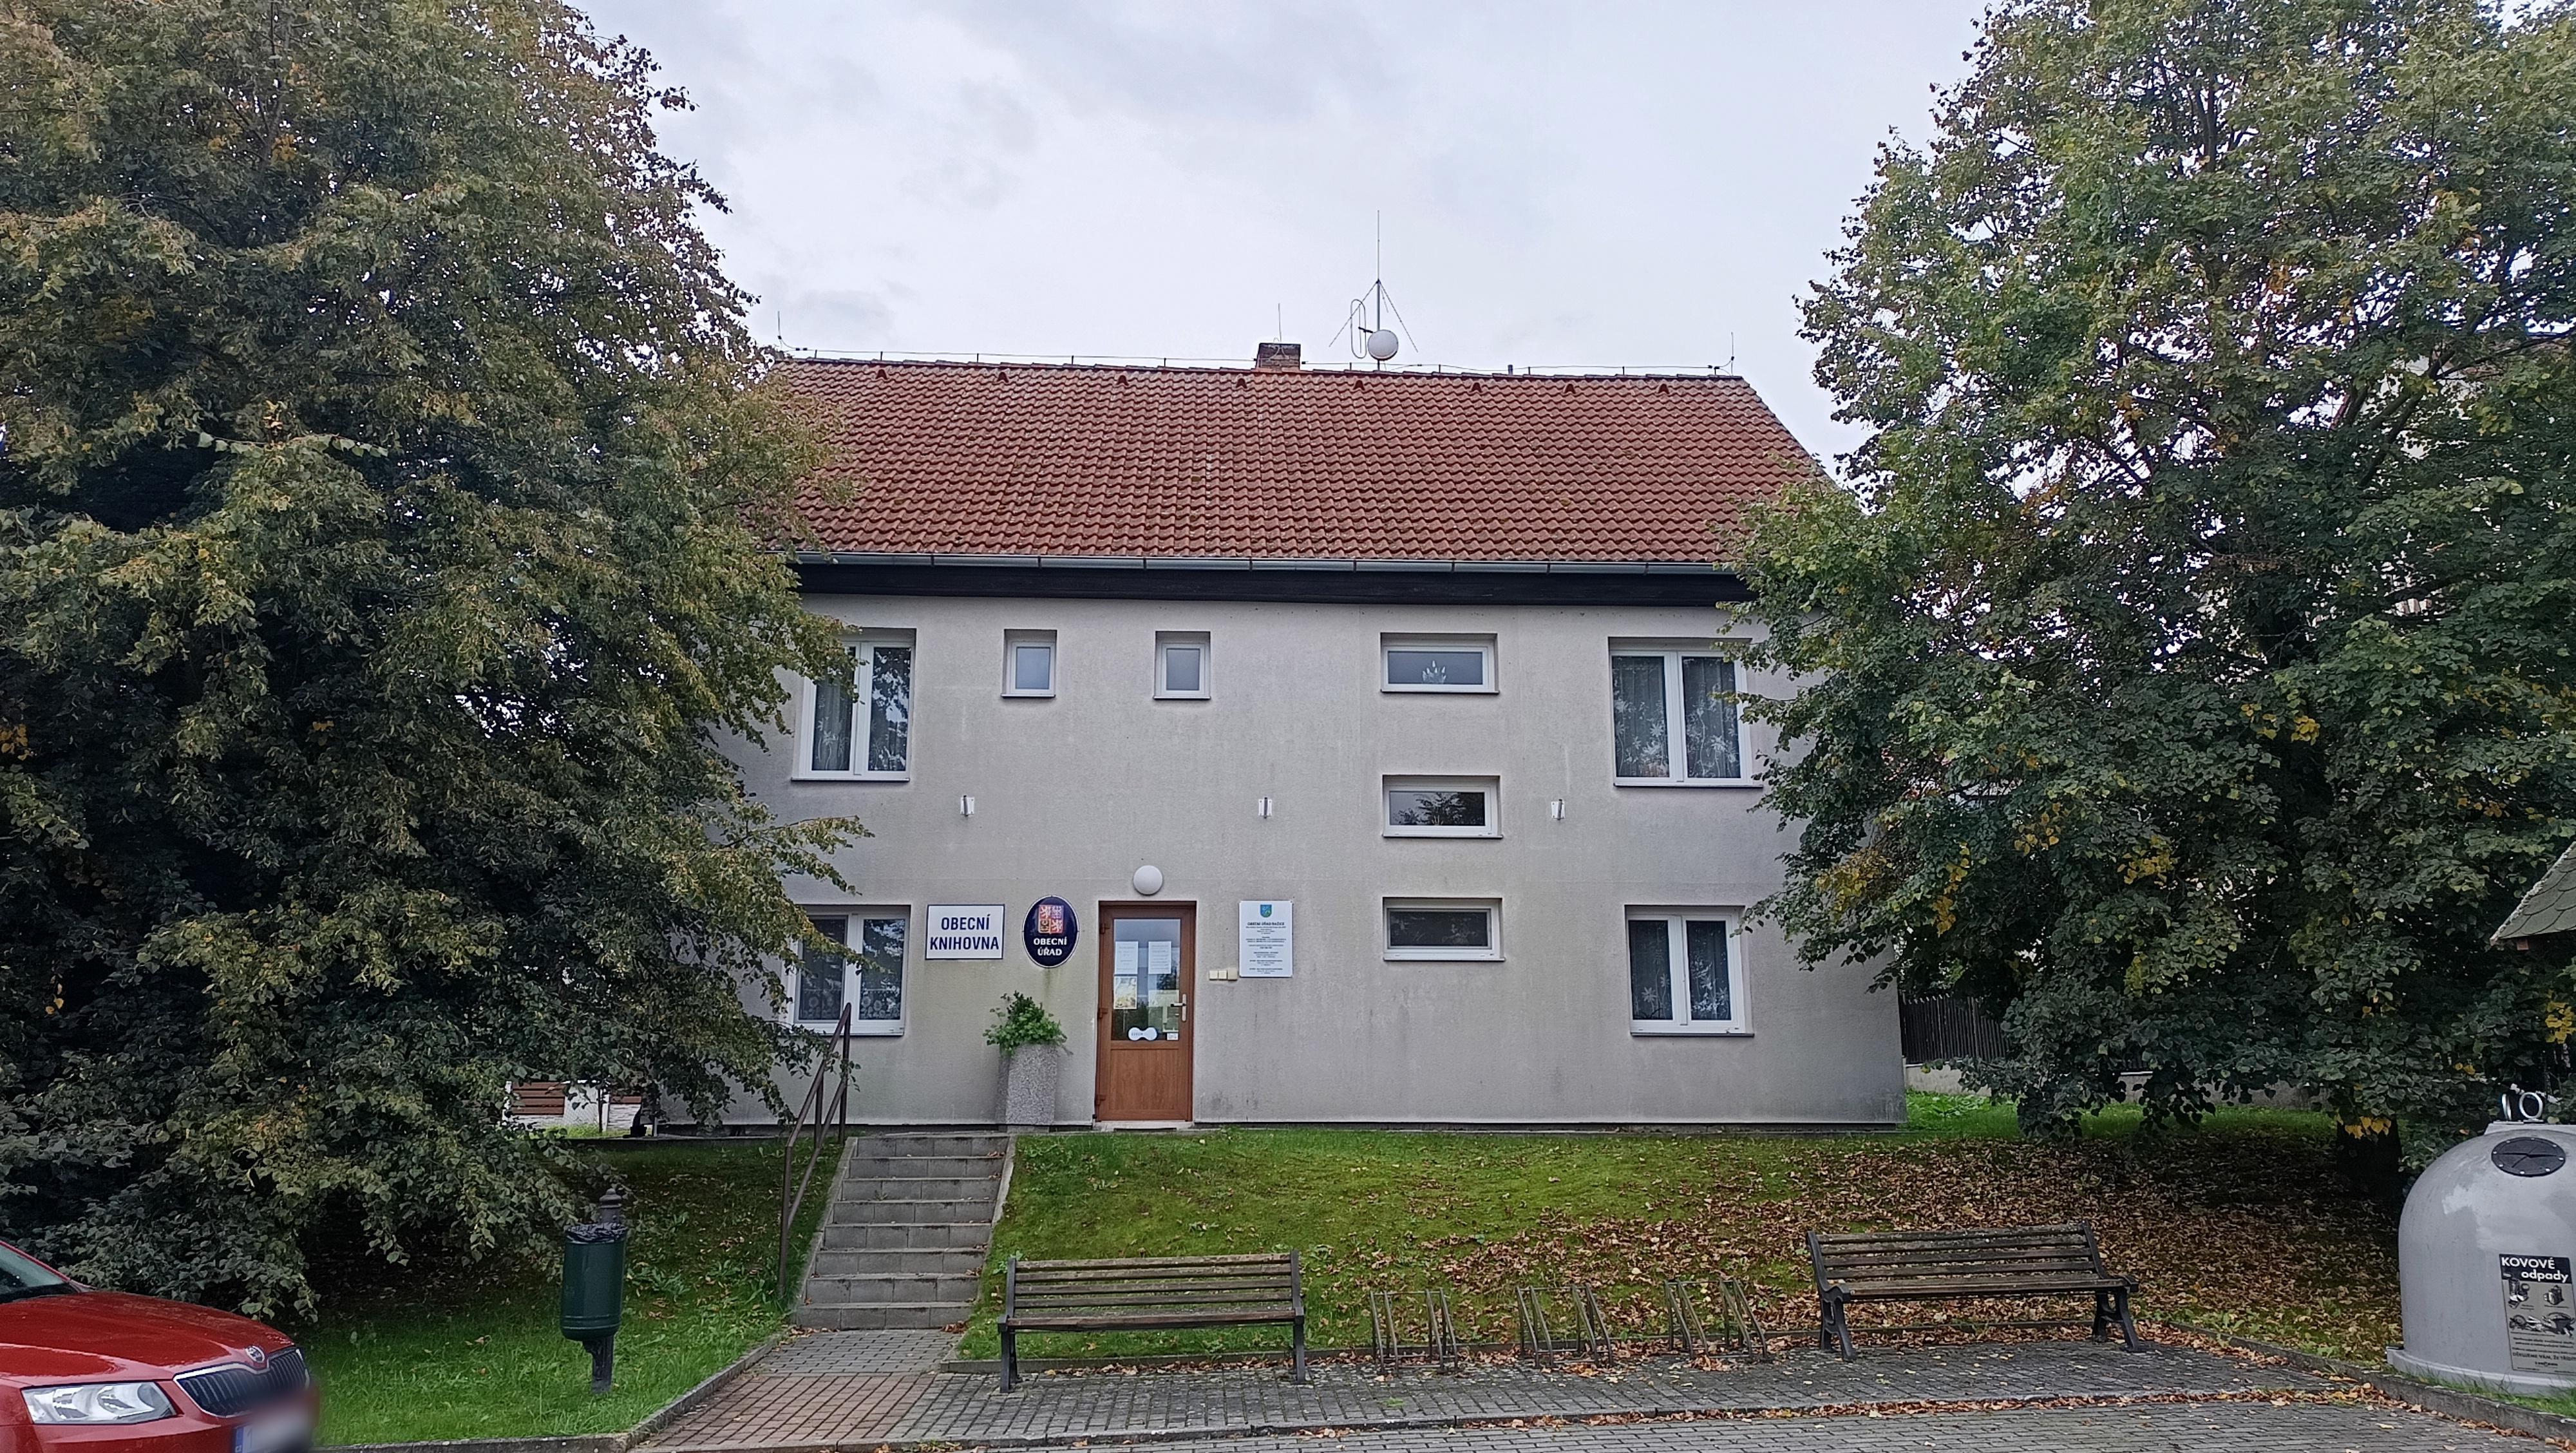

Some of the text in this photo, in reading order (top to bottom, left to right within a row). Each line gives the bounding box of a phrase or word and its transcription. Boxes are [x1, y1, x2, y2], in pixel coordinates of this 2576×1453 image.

[941, 914, 990, 931] OBECNÍ
[930, 936, 999, 950] KNIHOVNA
[1033, 936, 1067, 945] OBECNÍ
[1037, 946, 1063, 956] ÚŘAD
[2501, 1257, 2555, 1269] KOVOVÉ
[2521, 1269, 2568, 1283] odpady
